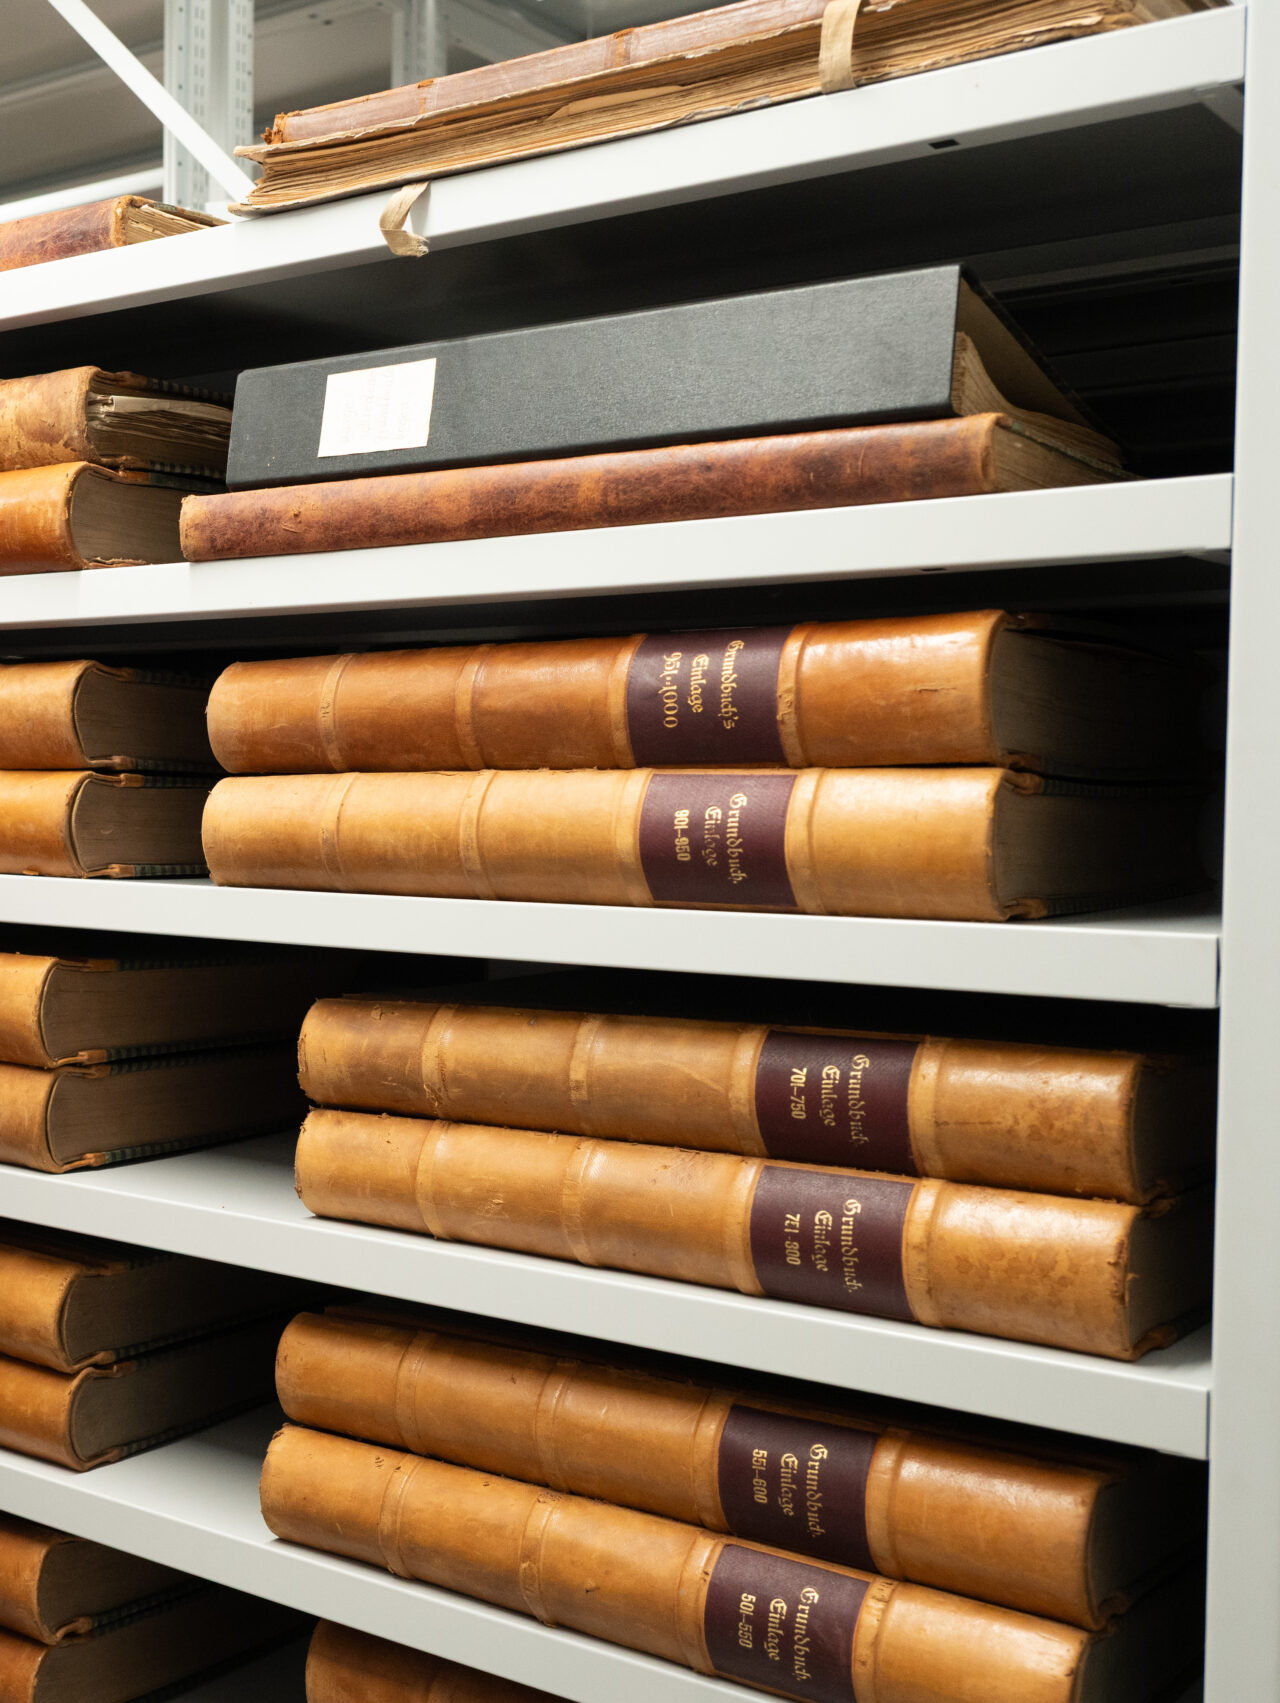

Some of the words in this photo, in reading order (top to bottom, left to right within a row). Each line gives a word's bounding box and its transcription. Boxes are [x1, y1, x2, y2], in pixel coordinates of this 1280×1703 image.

[688, 654, 709, 713] Einlage
[719, 640, 745, 730] Grundbuch's
[674, 810, 691, 861] 901-950
[701, 805, 722, 866] Einlage
[790, 1067, 807, 1119] 701-750
[819, 1065, 840, 1126] Einlage
[811, 1210, 833, 1272] Einlage
[752, 1449, 768, 1504] 551-600
[777, 1453, 799, 1518] Einlage
[738, 1593, 756, 1648] 501-550
[764, 1598, 787, 1662] Einlage
